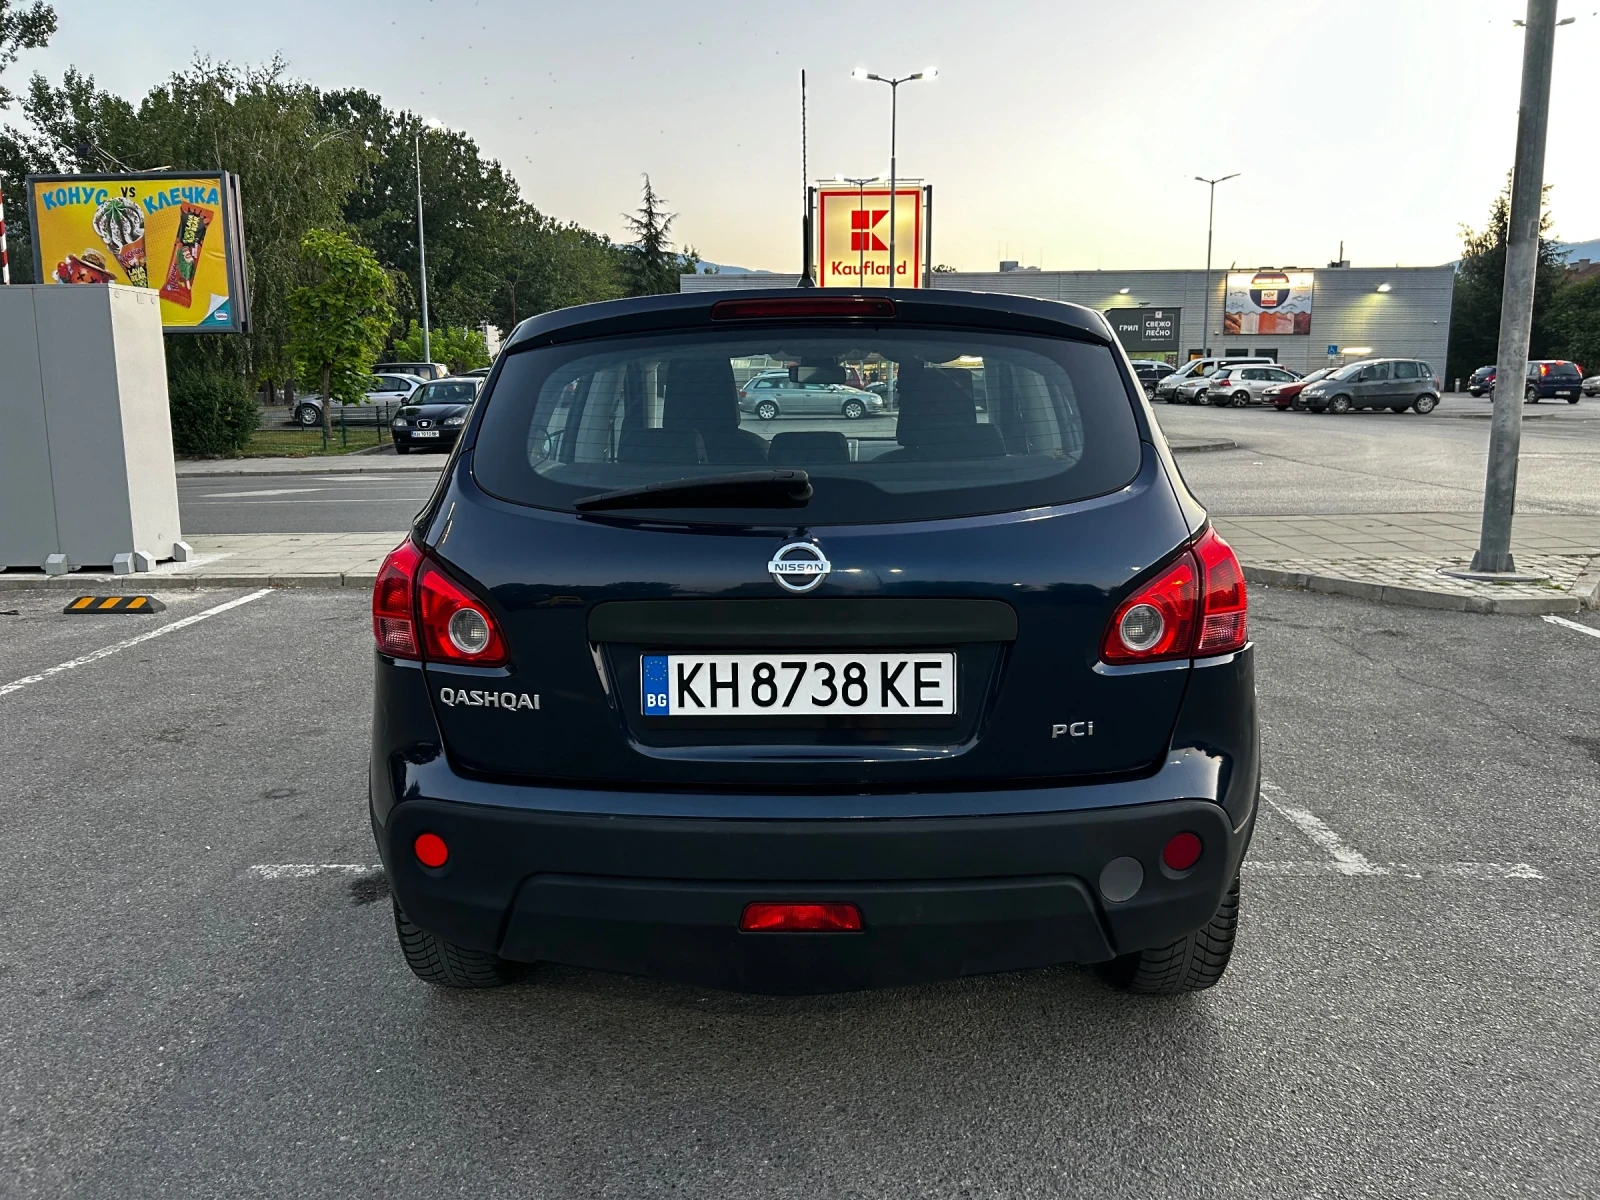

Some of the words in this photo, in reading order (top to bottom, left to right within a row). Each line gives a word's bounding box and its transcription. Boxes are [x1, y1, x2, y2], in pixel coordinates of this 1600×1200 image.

[42, 186, 108, 210] КОНУС
[120, 187, 136, 198] VS
[143, 186, 219, 215] КЛЕЧКА
[774, 563, 824, 571] NISSAN
[677, 662, 739, 708] KH
[751, 661, 868, 708] 8738
[880, 661, 944, 708] KE
[440, 687, 540, 712] QASHQAI
[647, 693, 667, 708] BG
